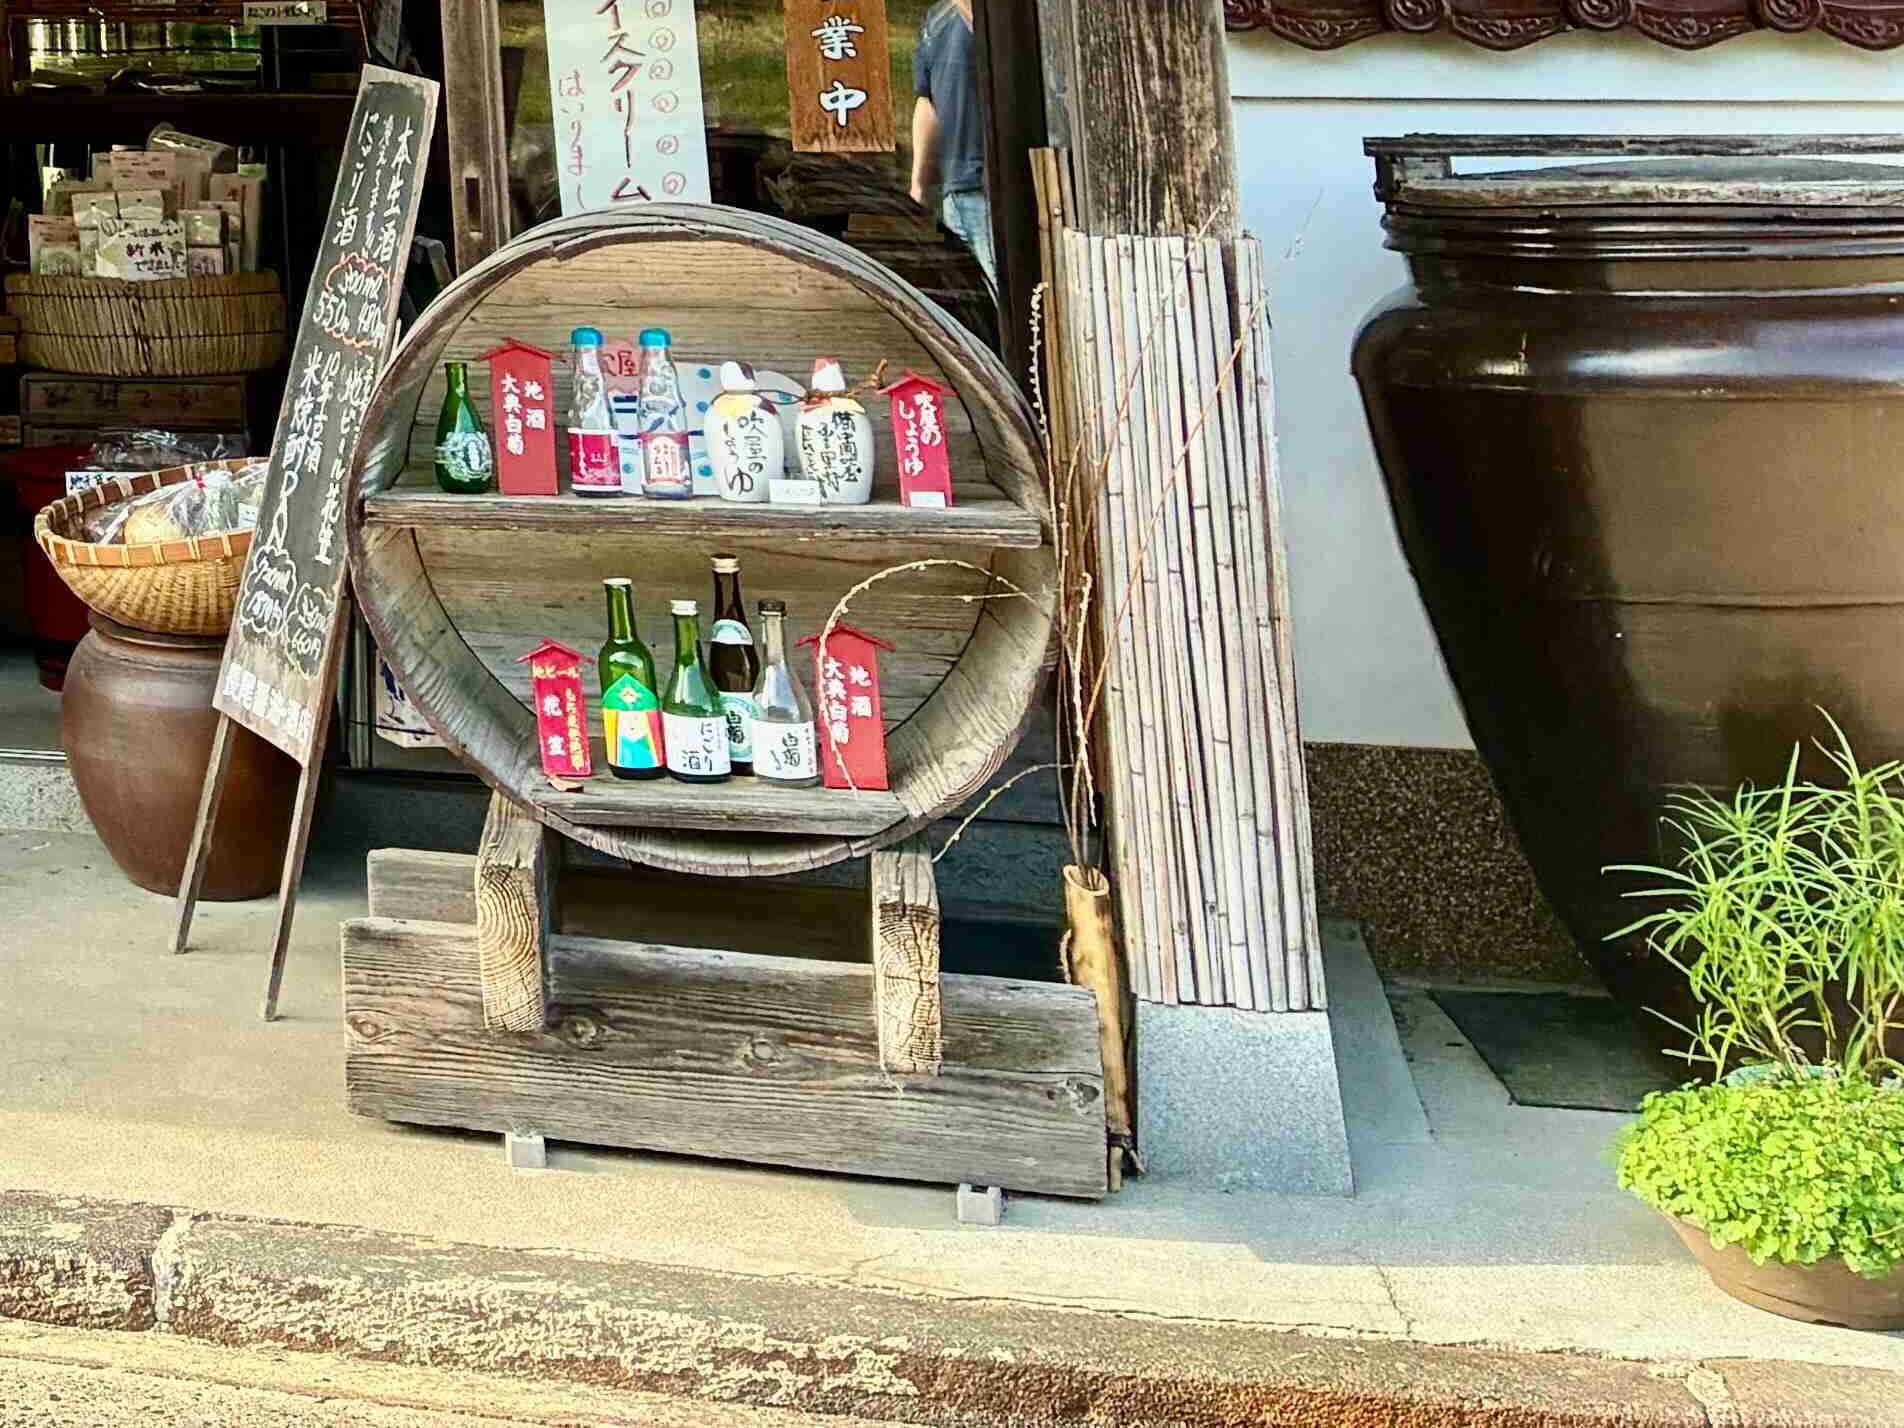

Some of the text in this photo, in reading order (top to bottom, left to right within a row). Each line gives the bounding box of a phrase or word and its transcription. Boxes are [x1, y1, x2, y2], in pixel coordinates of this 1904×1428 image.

[374, 117, 414, 262] 本生酒
[500, 373, 524, 456] 大典白菊
[524, 380, 546, 431] 地酒
[898, 399, 924, 476] しょうゆ
[915, 391, 941, 447] 吹屋の
[848, 664, 873, 718] 地酒
